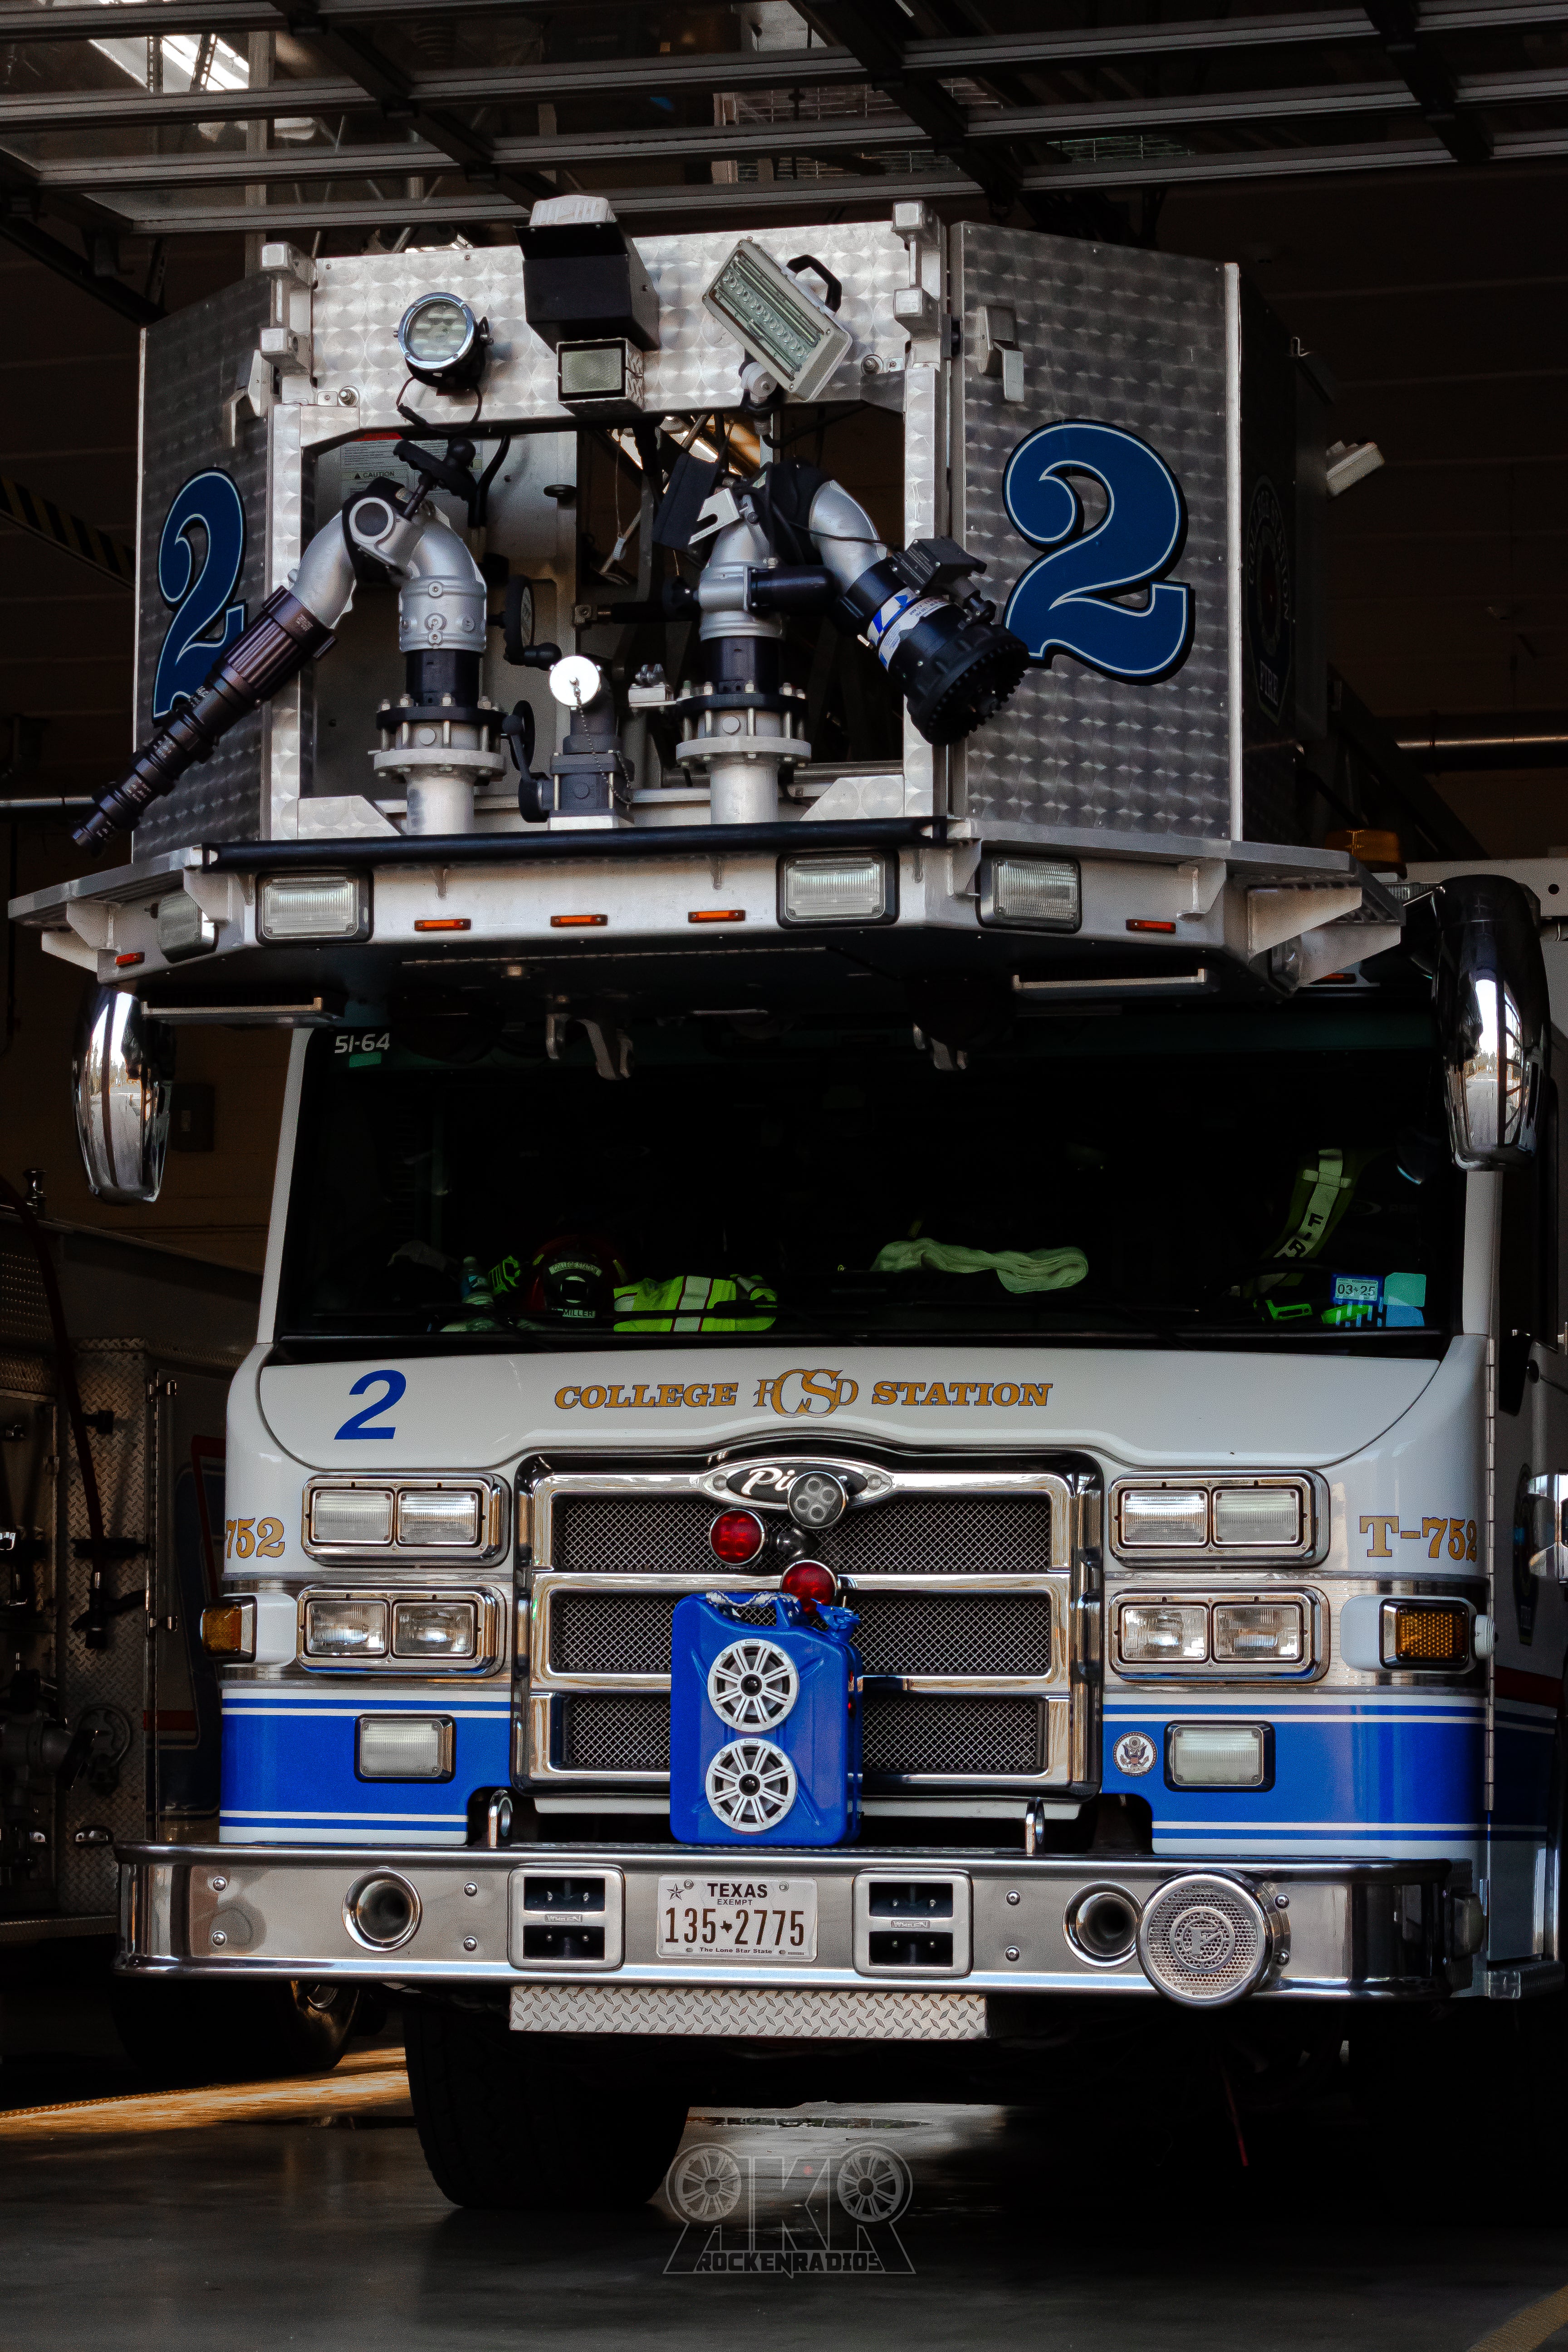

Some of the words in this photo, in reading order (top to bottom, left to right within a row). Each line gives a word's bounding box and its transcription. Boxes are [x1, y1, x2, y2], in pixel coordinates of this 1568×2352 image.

[1002, 418, 1196, 686] 2
[152, 466, 248, 725] 2
[334, 1033, 390, 1054] 51-64
[334, 1370, 407, 1440] 2
[554, 1382, 737, 1410] COLLEGE
[871, 1382, 1054, 1407] STATION
[1359, 1515, 1477, 1563] T-752
[707, 1882, 768, 1898] TEXAS
